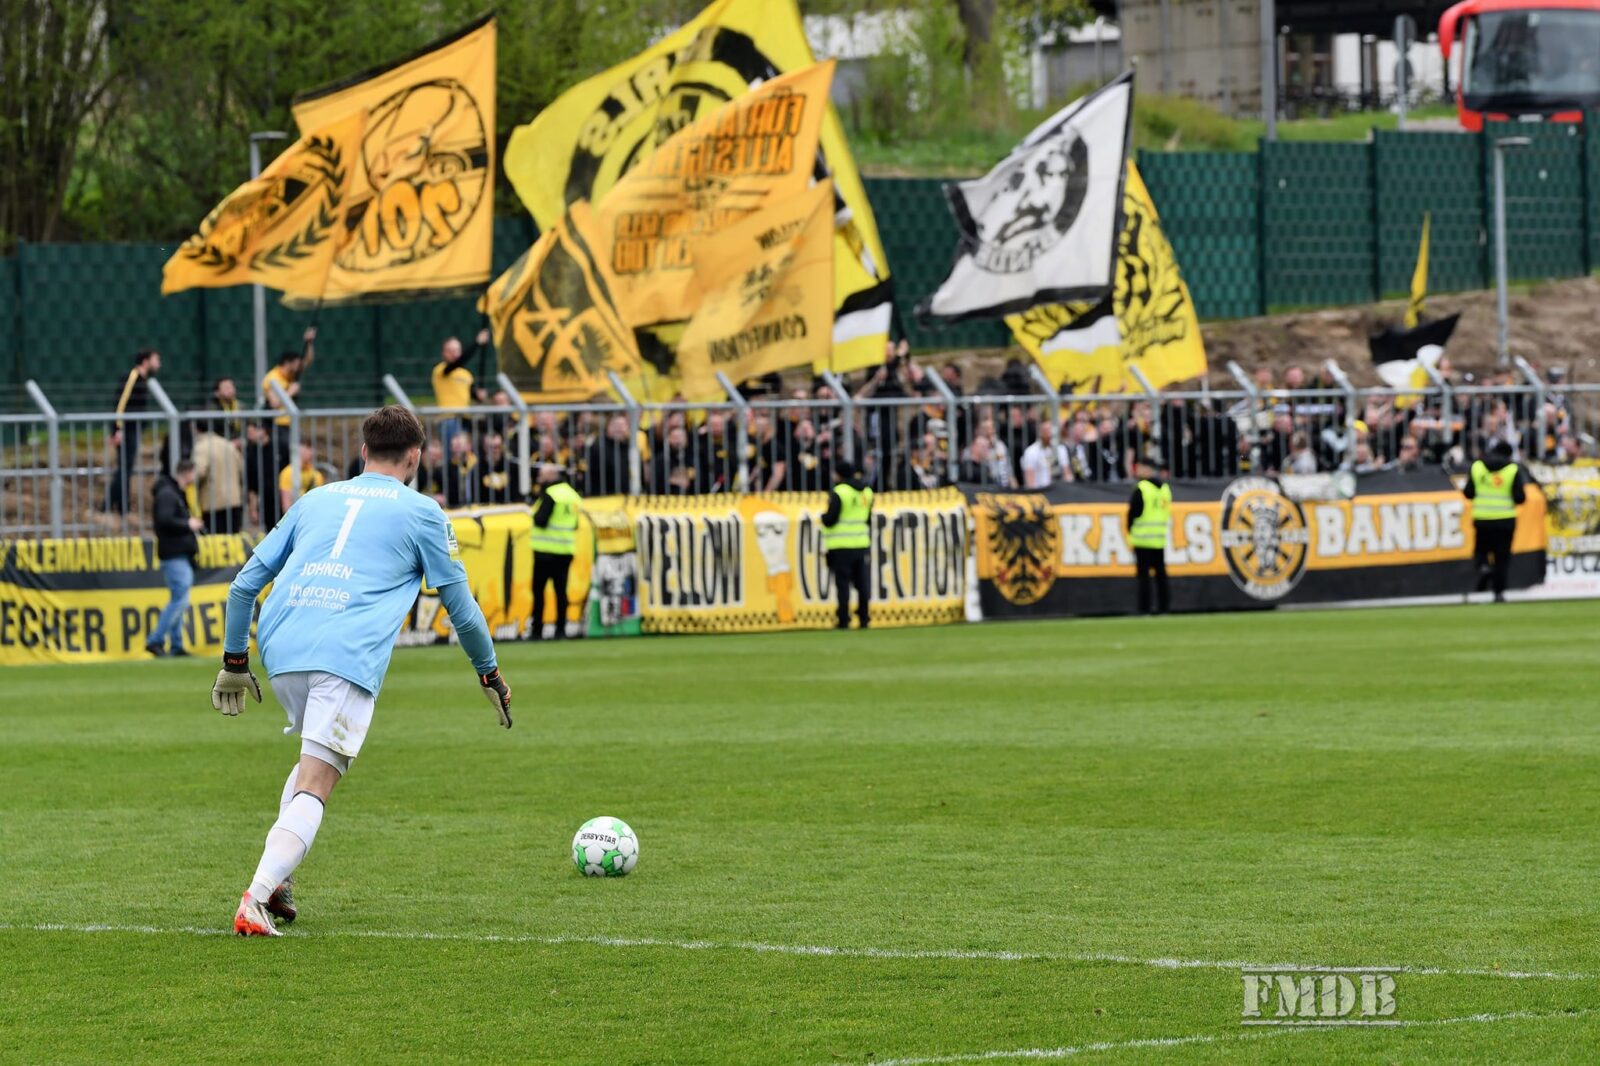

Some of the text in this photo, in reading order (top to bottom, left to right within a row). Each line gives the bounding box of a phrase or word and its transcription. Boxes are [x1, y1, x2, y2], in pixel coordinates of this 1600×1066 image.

[326, 482, 399, 500] ALEMANNIA
[329, 498, 364, 560] 1
[1060, 500, 1466, 566] KALS BANDE
[16, 536, 147, 573] ALEMANNIA
[637, 514, 742, 607] YELLOW
[300, 562, 353, 580] JOHNEN
[289, 583, 350, 601] therapie
[580, 832, 616, 845] DERBYSTAR
